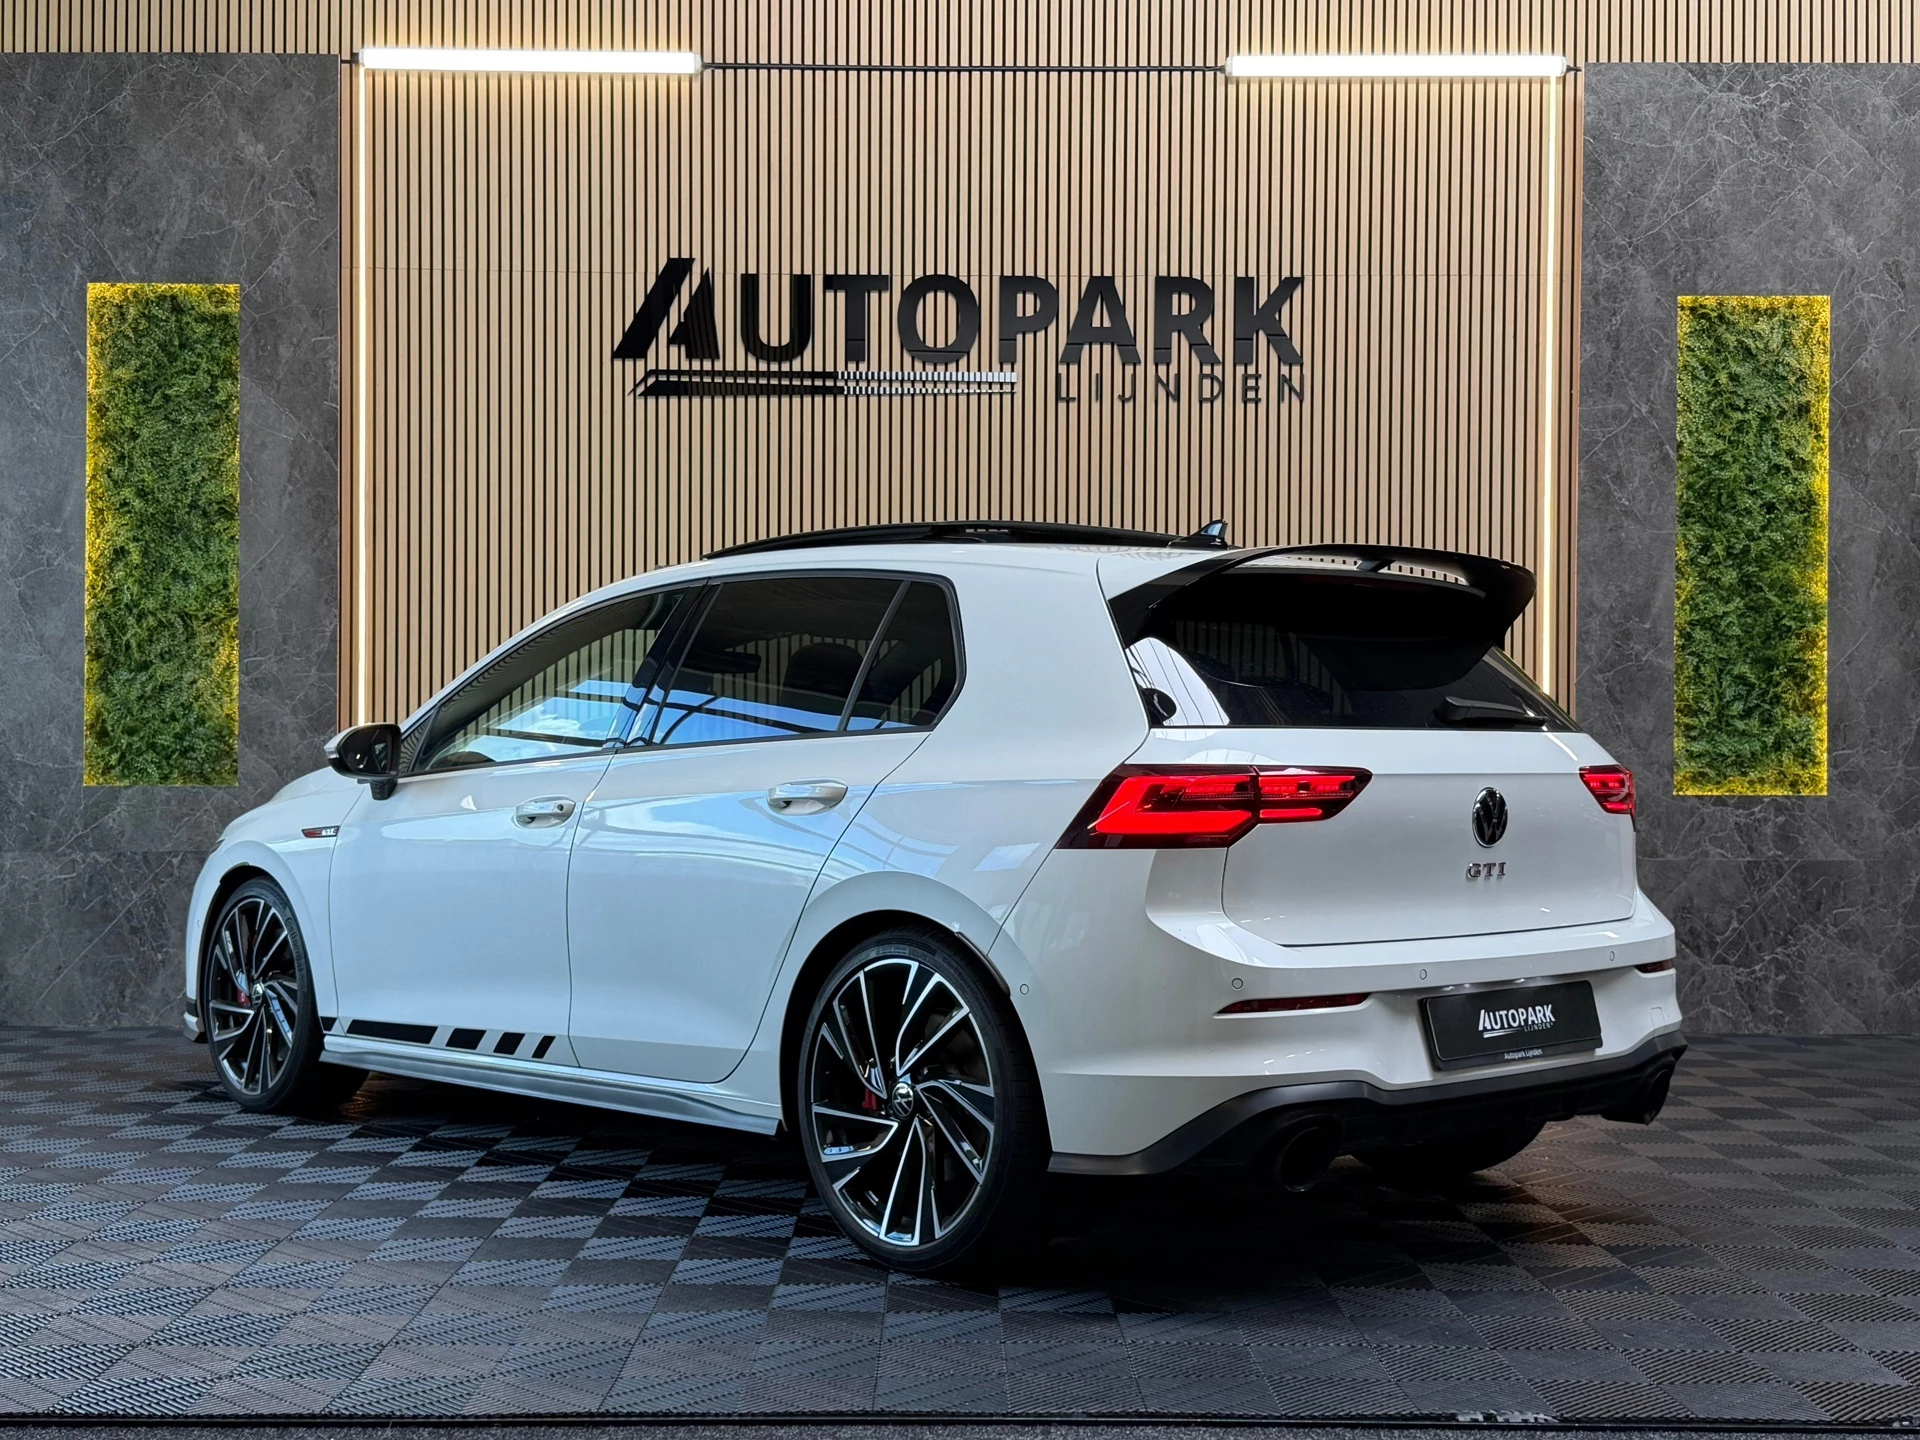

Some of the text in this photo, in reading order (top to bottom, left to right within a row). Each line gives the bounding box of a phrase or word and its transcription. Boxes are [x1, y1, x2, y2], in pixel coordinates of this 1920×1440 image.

[611, 257, 1304, 364] AUTOPARK
[1057, 373, 1304, 403] LIJNDEN
[1467, 862, 1506, 879] GTI
[1478, 1004, 1556, 1031] AUTOPARK
[1504, 1050, 1526, 1060] Autopark
